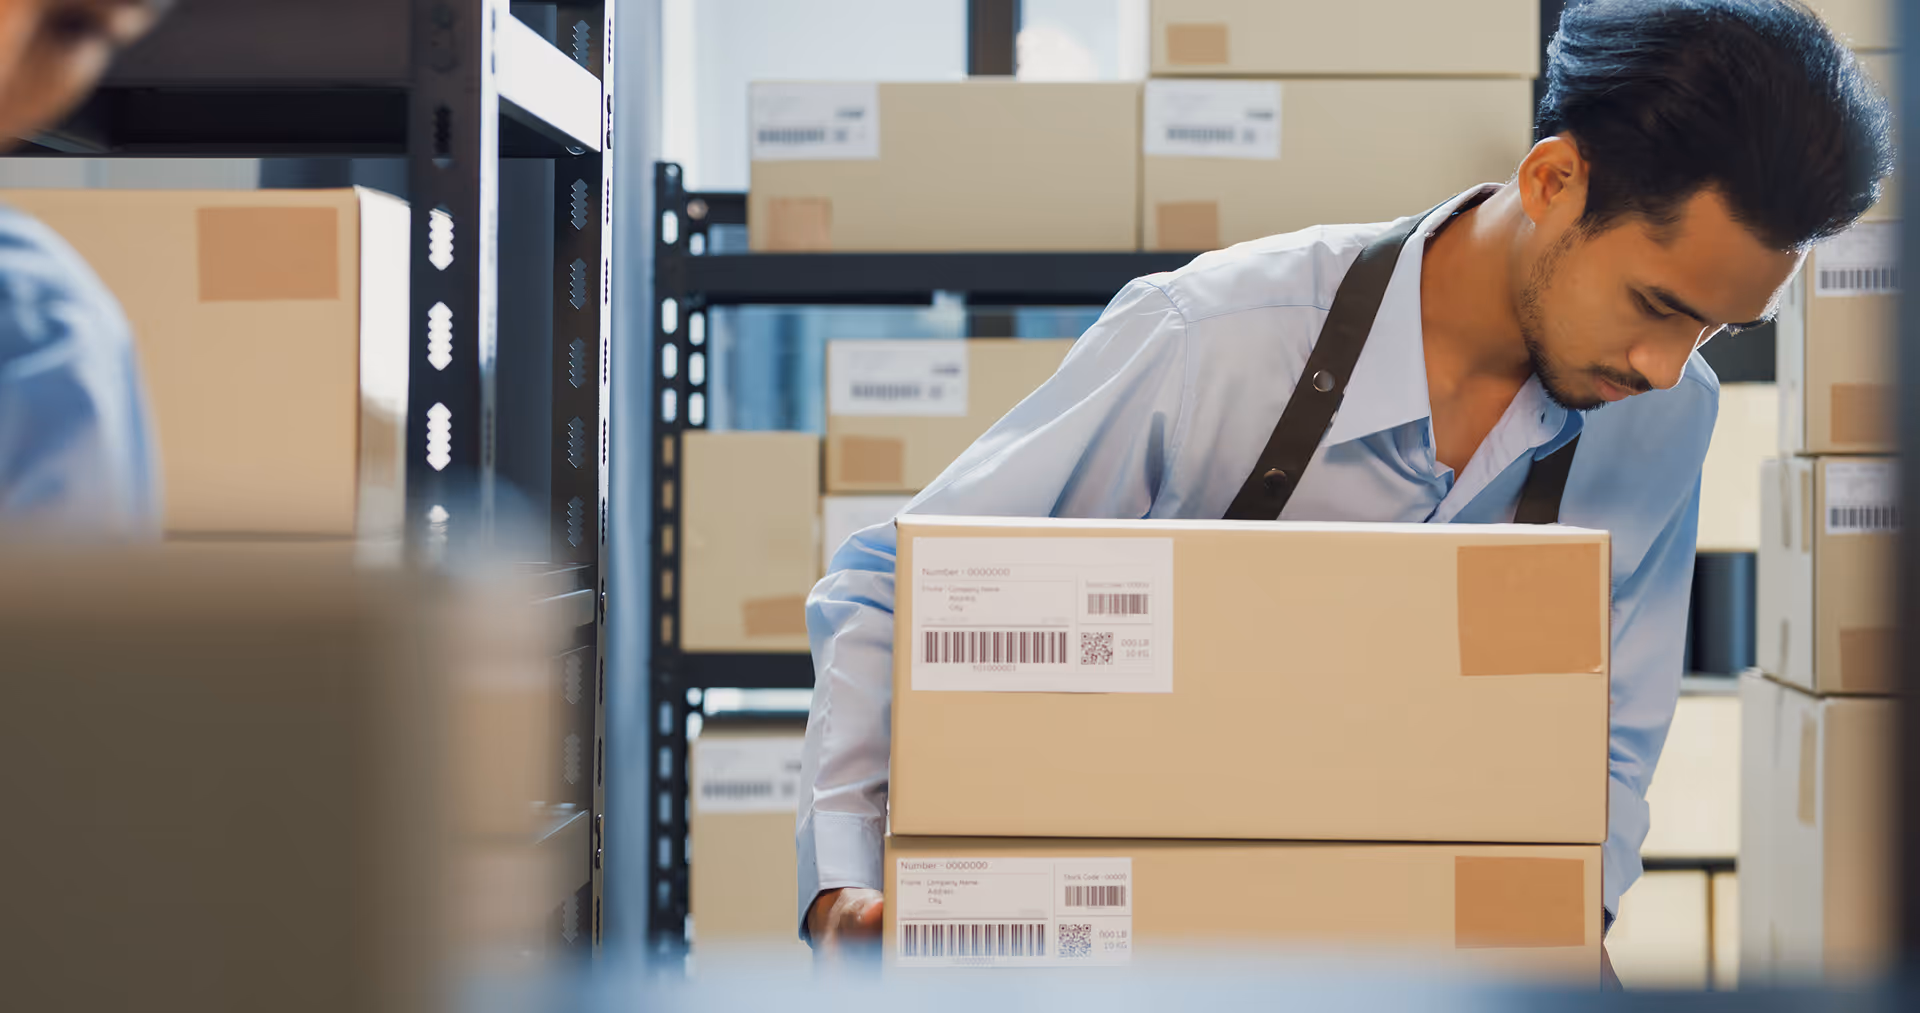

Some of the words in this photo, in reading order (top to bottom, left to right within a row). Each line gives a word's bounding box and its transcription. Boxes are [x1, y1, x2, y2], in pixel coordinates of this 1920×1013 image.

[922, 567, 958, 577] Number
[900, 861, 936, 870] Number
[946, 861, 988, 870] 0000000
